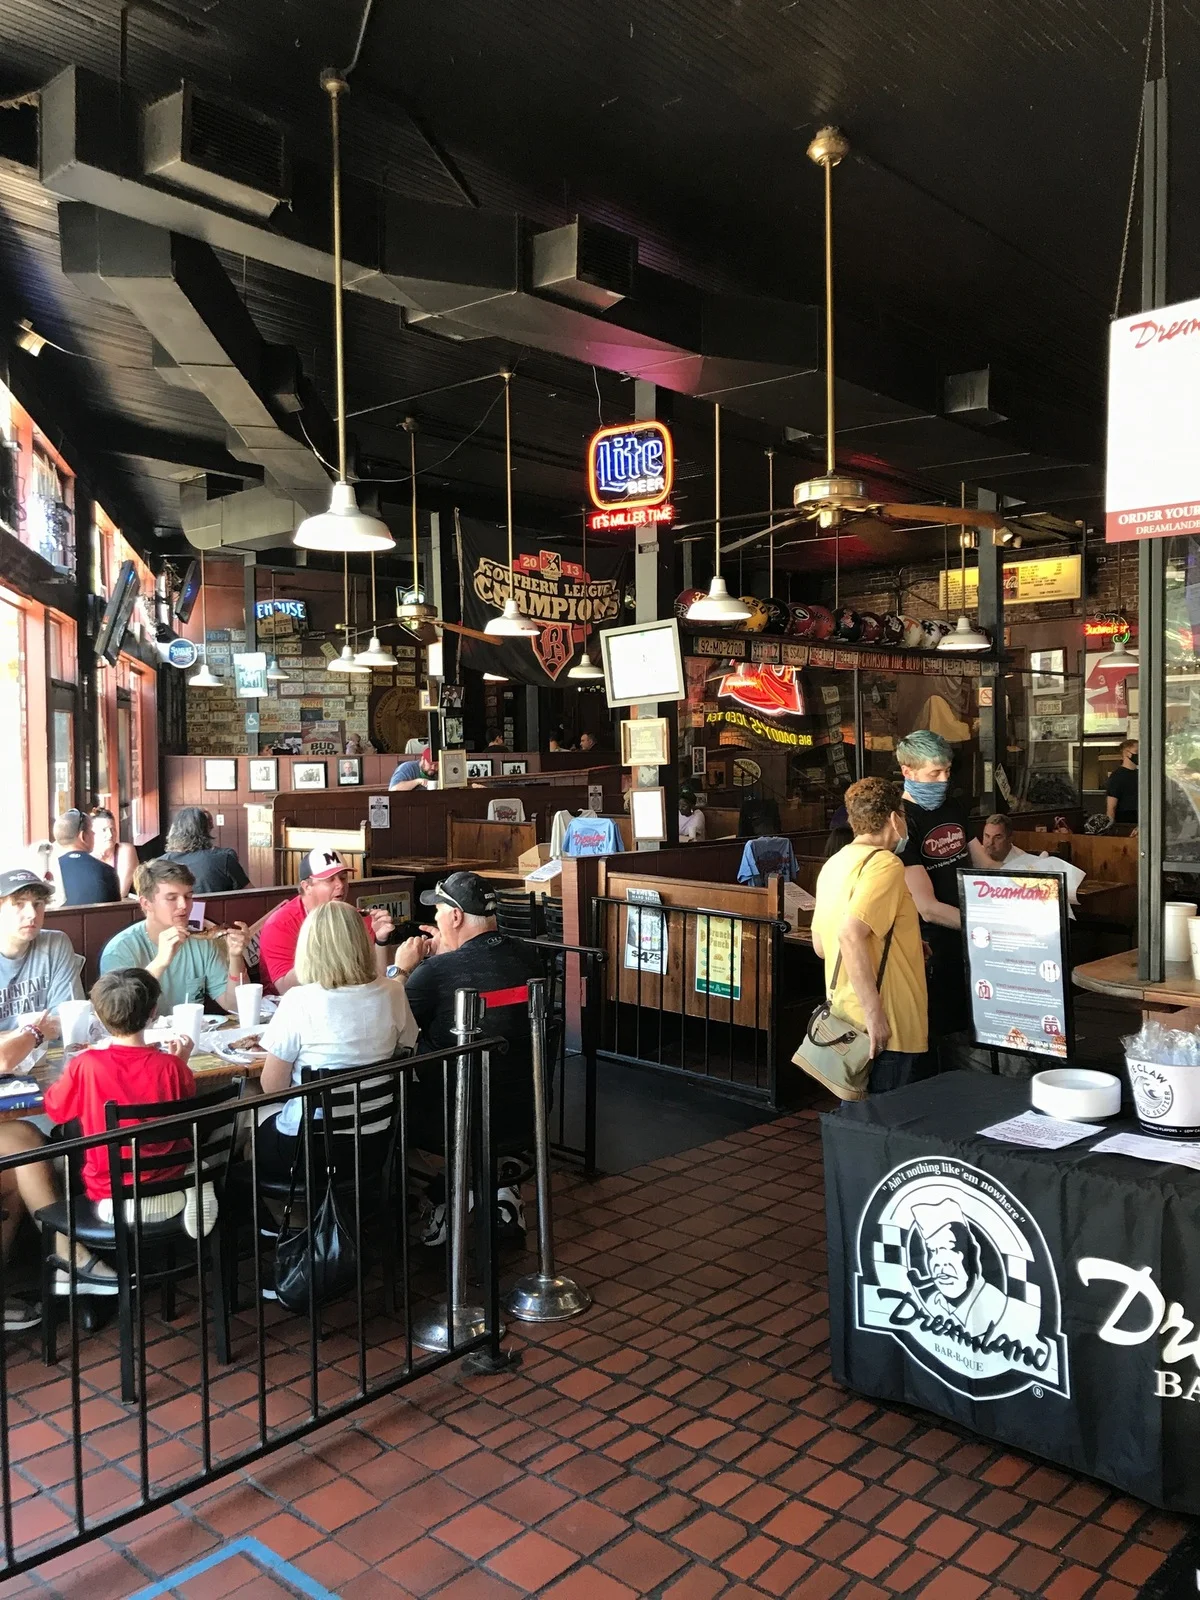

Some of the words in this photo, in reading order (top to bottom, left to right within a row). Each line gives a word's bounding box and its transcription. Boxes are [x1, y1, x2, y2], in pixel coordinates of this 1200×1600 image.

[597, 437, 663, 492] Lite
[627, 478, 665, 494] BEER
[593, 513, 609, 529] IT'S
[611, 508, 646, 526] MILLER
[648, 506, 672, 523] TIME
[1118, 510, 1163, 525] ORDER
[523, 556, 537, 567] 20
[566, 564, 580, 575] 13
[485, 562, 558, 595] SOUTHERN
[564, 583, 613, 597] LEAGUE
[475, 575, 618, 621] CHAMPIONS
[257, 602, 306, 618] EHOUSE
[862, 652, 889, 668] CRIMSON
[311, 742, 335, 750] BUD
[323, 852, 341, 866] M
[973, 881, 1051, 900] Dreamland
[1137, 1064, 1167, 1083] CLAW
[1153, 1090, 1170, 1115] SELTZER
[907, 1162, 941, 1178] nothing
[942, 1161, 960, 1175] like
[877, 1287, 1050, 1372] Dreamland
[934, 1342, 984, 1372] BAR-B-QUE
